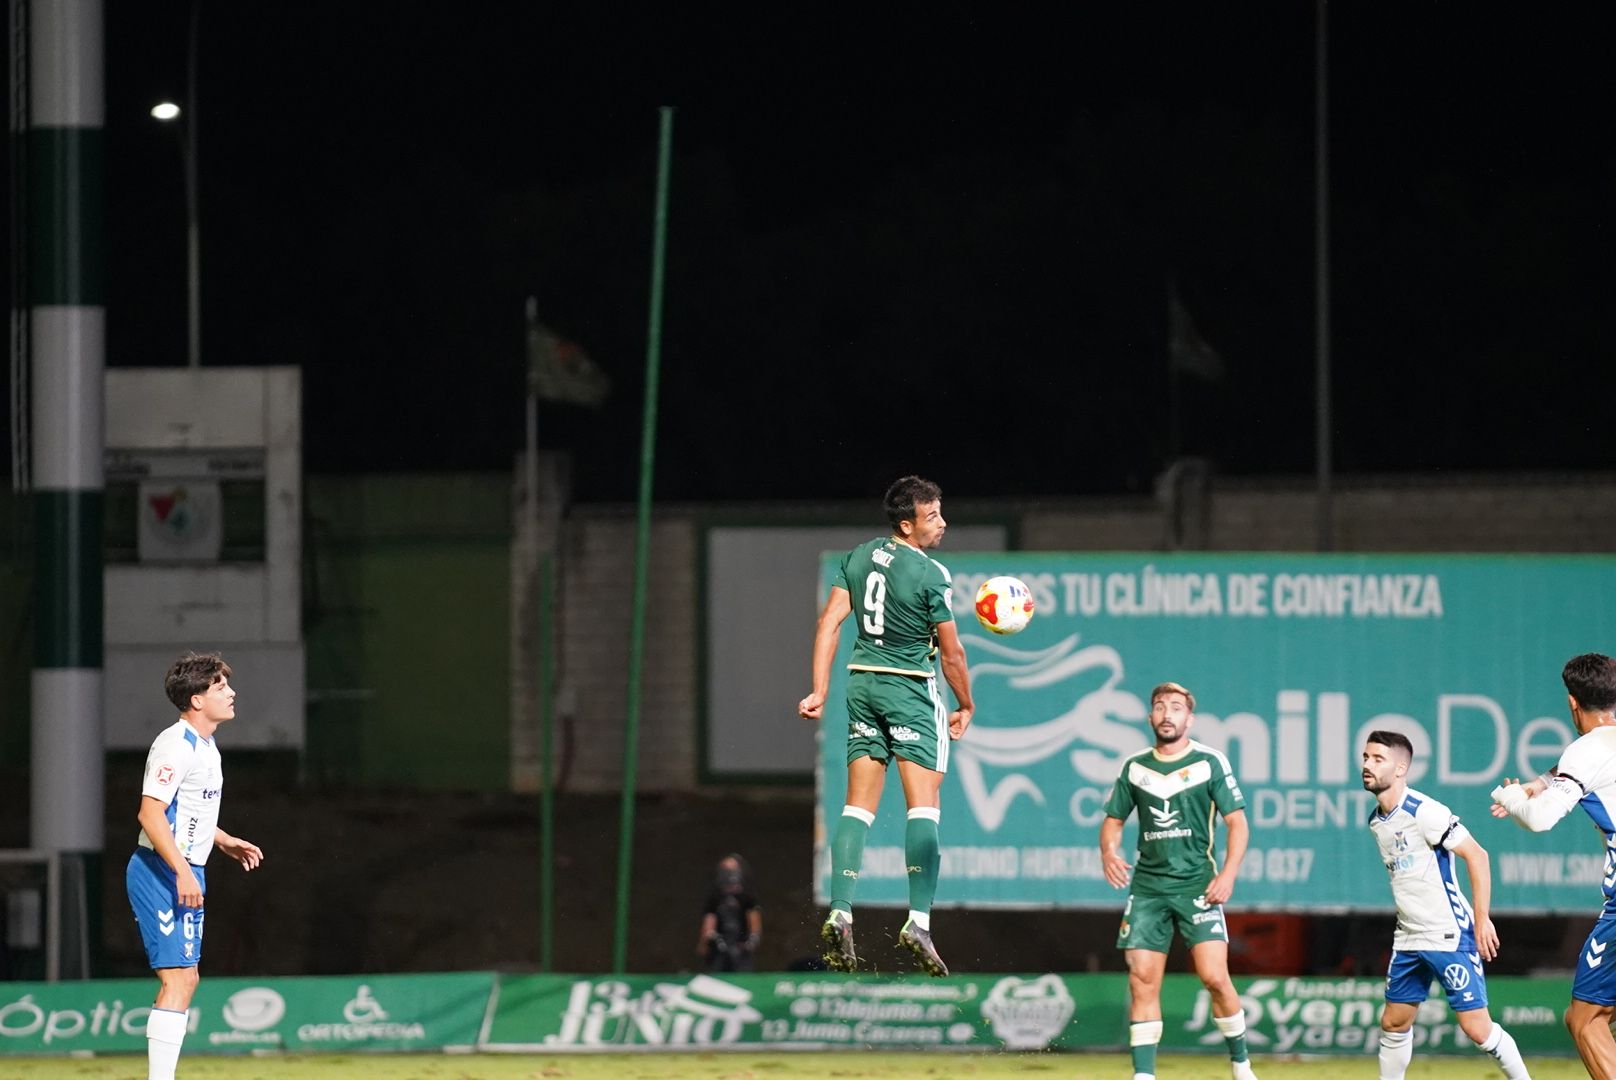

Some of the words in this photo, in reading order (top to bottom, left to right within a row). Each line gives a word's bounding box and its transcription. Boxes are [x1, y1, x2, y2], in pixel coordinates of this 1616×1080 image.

[864, 570, 886, 635] 9
[1061, 571, 1100, 616] TU
[1106, 564, 1223, 617] CLÍNICA
[1228, 573, 1268, 617] DE
[1273, 573, 1443, 618] CONFIANZA
[1252, 788, 1376, 829] DENT
